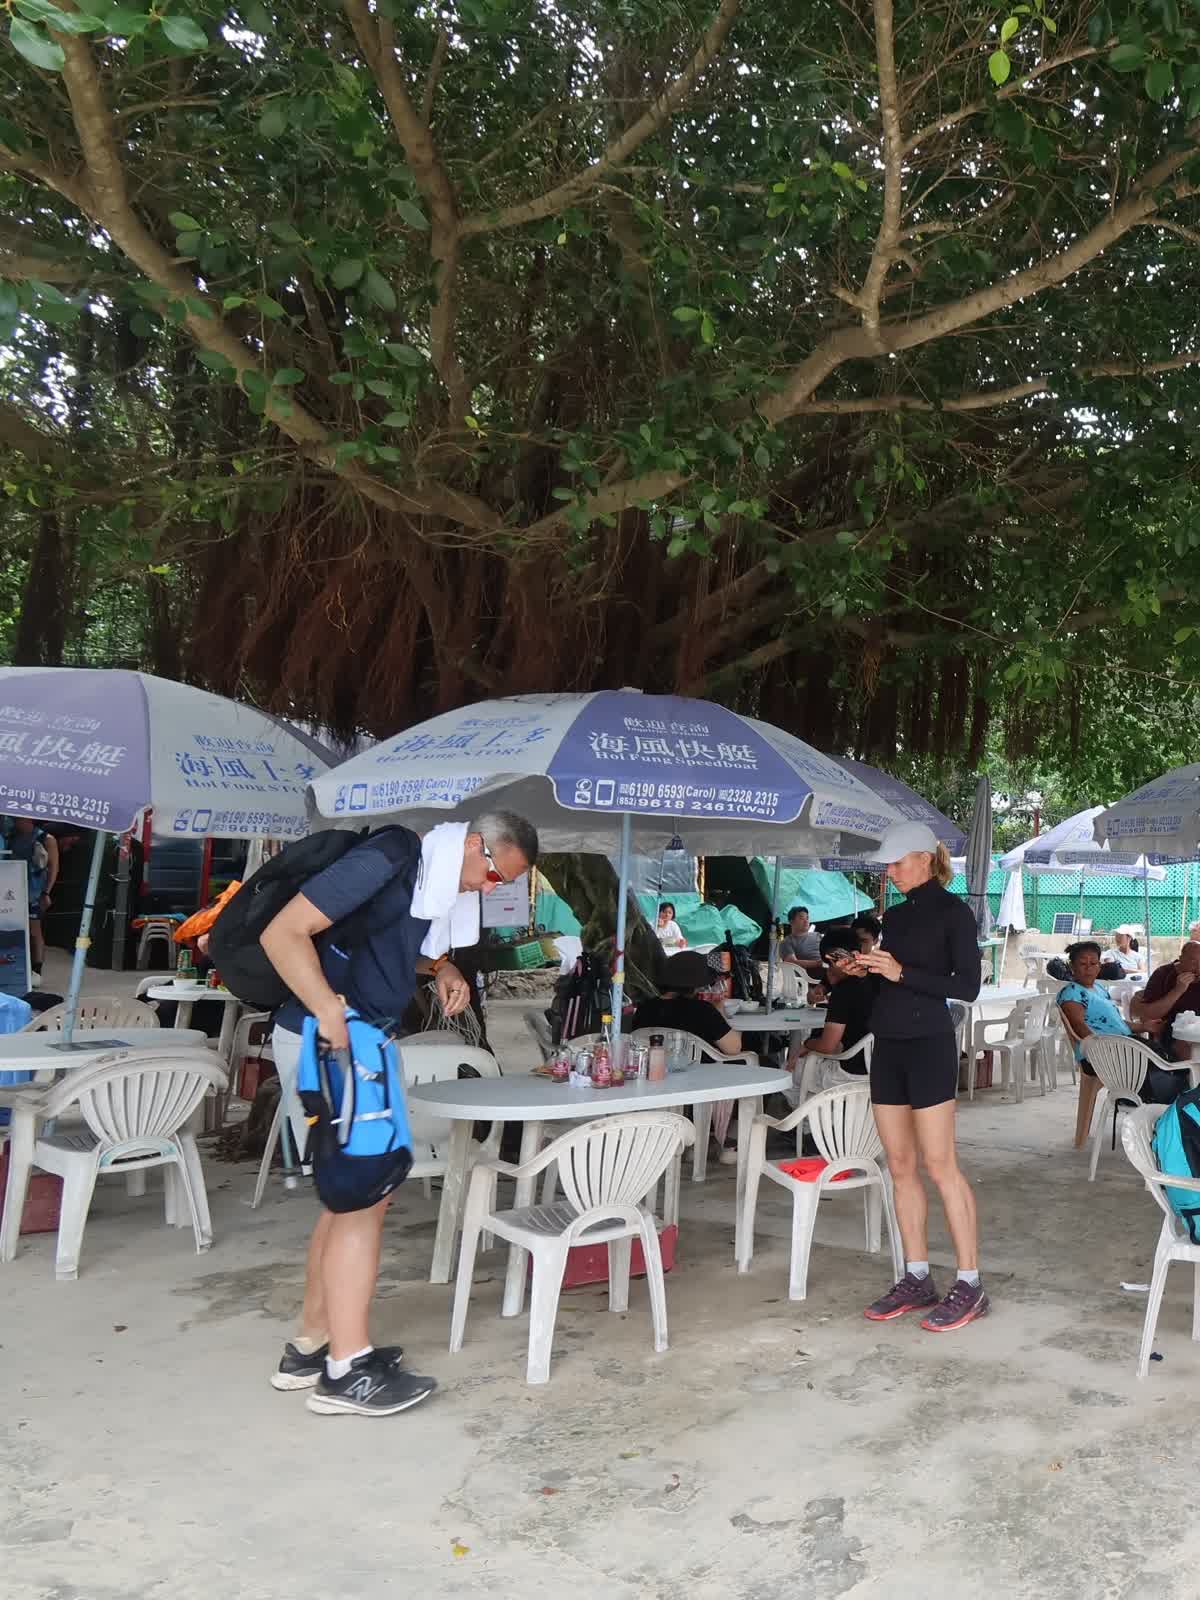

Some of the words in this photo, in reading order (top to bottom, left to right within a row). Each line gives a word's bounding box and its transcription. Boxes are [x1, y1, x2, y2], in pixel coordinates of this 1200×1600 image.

[588, 731, 757, 763] 海風快艇
[675, 757, 759, 771] Speedboat
[81, 797, 110, 815] 2315
[754, 791, 780, 807] 2315
[6, 800, 107, 825] 2461(Wai)
[691, 800, 776, 817] 2461(Wai)
